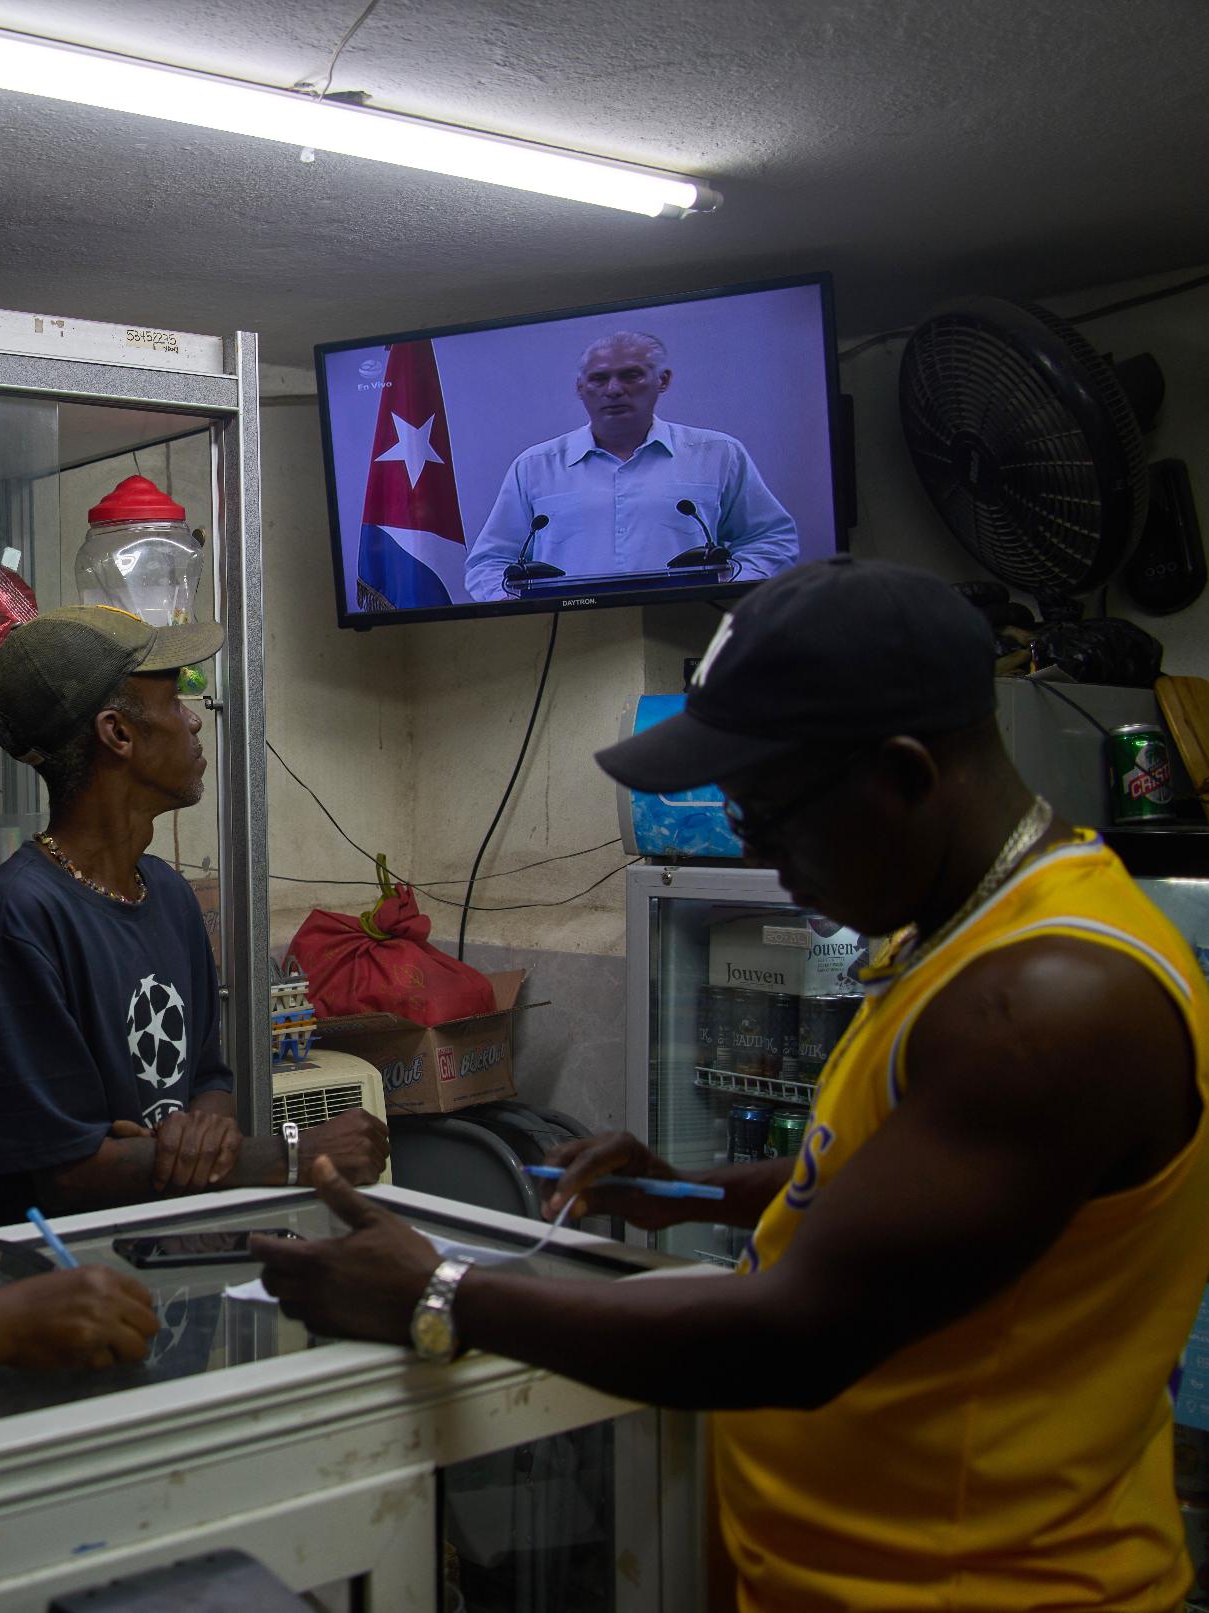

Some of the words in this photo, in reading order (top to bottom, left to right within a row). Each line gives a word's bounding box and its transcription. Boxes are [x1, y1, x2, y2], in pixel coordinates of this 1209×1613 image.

[357, 383, 369, 392] En
[371, 380, 393, 390] Vivo
[807, 943, 854, 961] Jouven
[726, 962, 786, 986] Jouven
